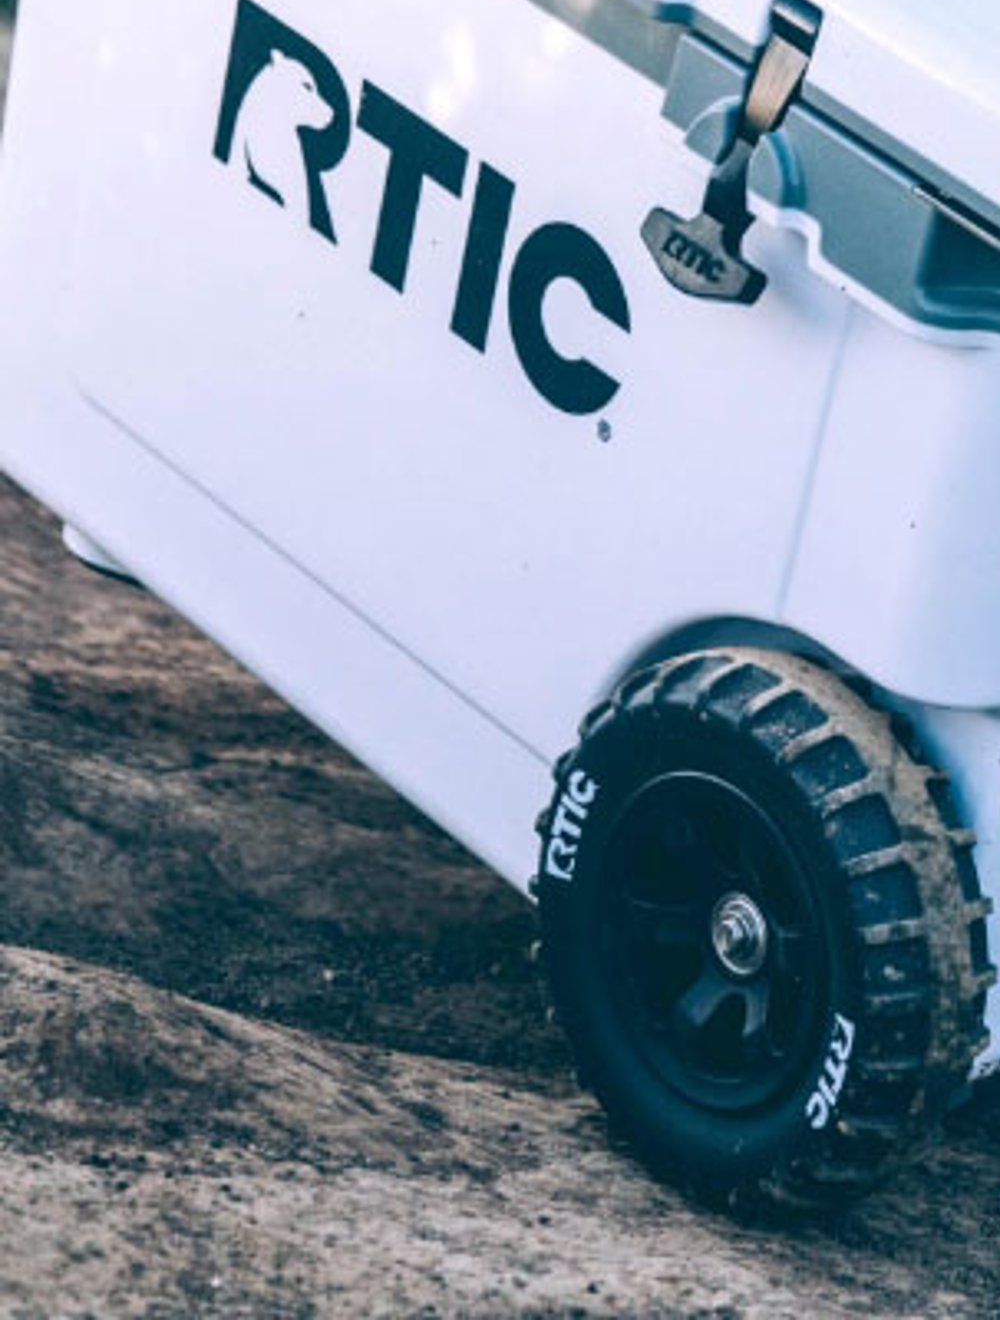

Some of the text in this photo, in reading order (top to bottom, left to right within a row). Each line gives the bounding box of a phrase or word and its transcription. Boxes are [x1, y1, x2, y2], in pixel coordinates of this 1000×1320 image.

[661, 229, 727, 282] RTIC
[546, 768, 598, 881] RTIC
[805, 1012, 855, 1129] RTIC
